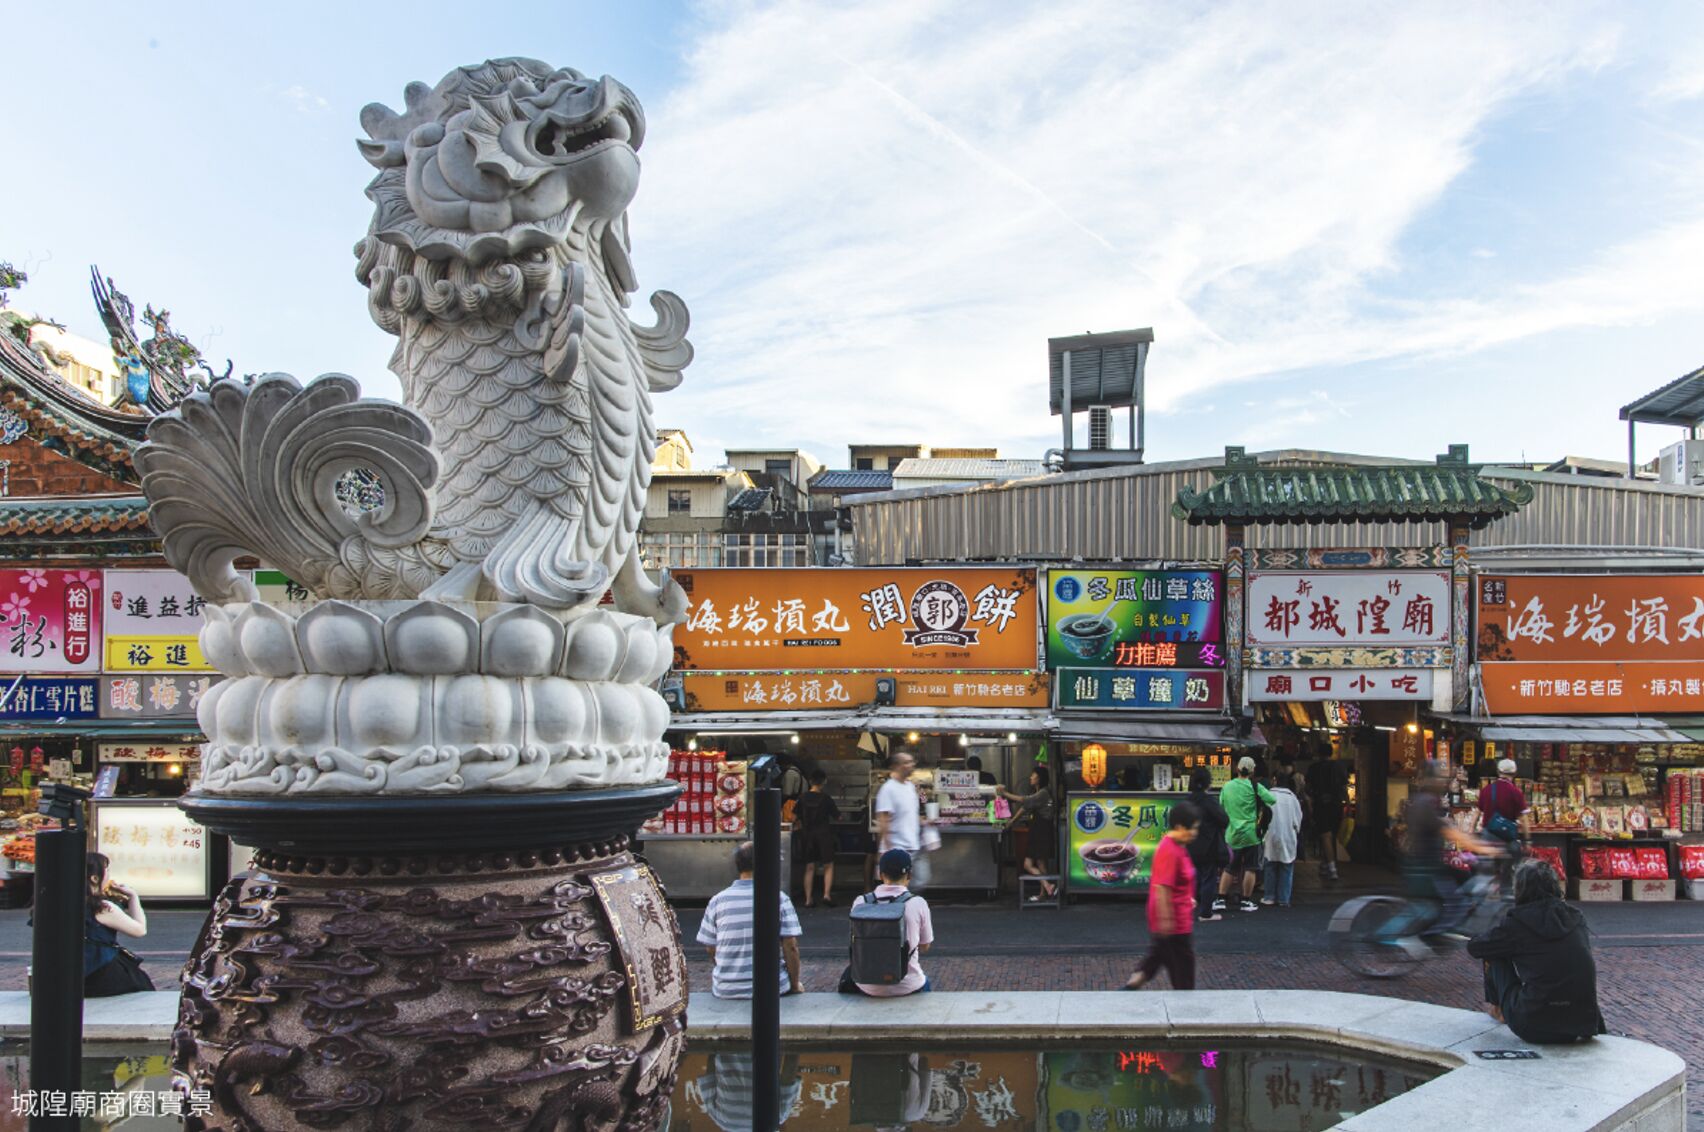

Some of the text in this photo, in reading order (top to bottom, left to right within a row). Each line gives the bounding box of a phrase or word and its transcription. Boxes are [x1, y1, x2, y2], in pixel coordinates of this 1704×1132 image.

[1088, 577, 1216, 601] 冬瓜仙草絲
[860, 582, 908, 632] 潤
[972, 584, 1021, 634] 餅
[927, 596, 955, 626] 郭
[1133, 612, 1191, 627] 自製仙草
[1264, 594, 1435, 638] 都城隍廟
[67, 588, 88, 657] 裕進行
[128, 644, 209, 665] 裕進
[1115, 642, 1178, 666] 力推薦
[953, 683, 1026, 696] 新竹馳名老店
[1264, 675, 1419, 695] 廟口小吃
[1650, 679, 1704, 696] 摃丸製
